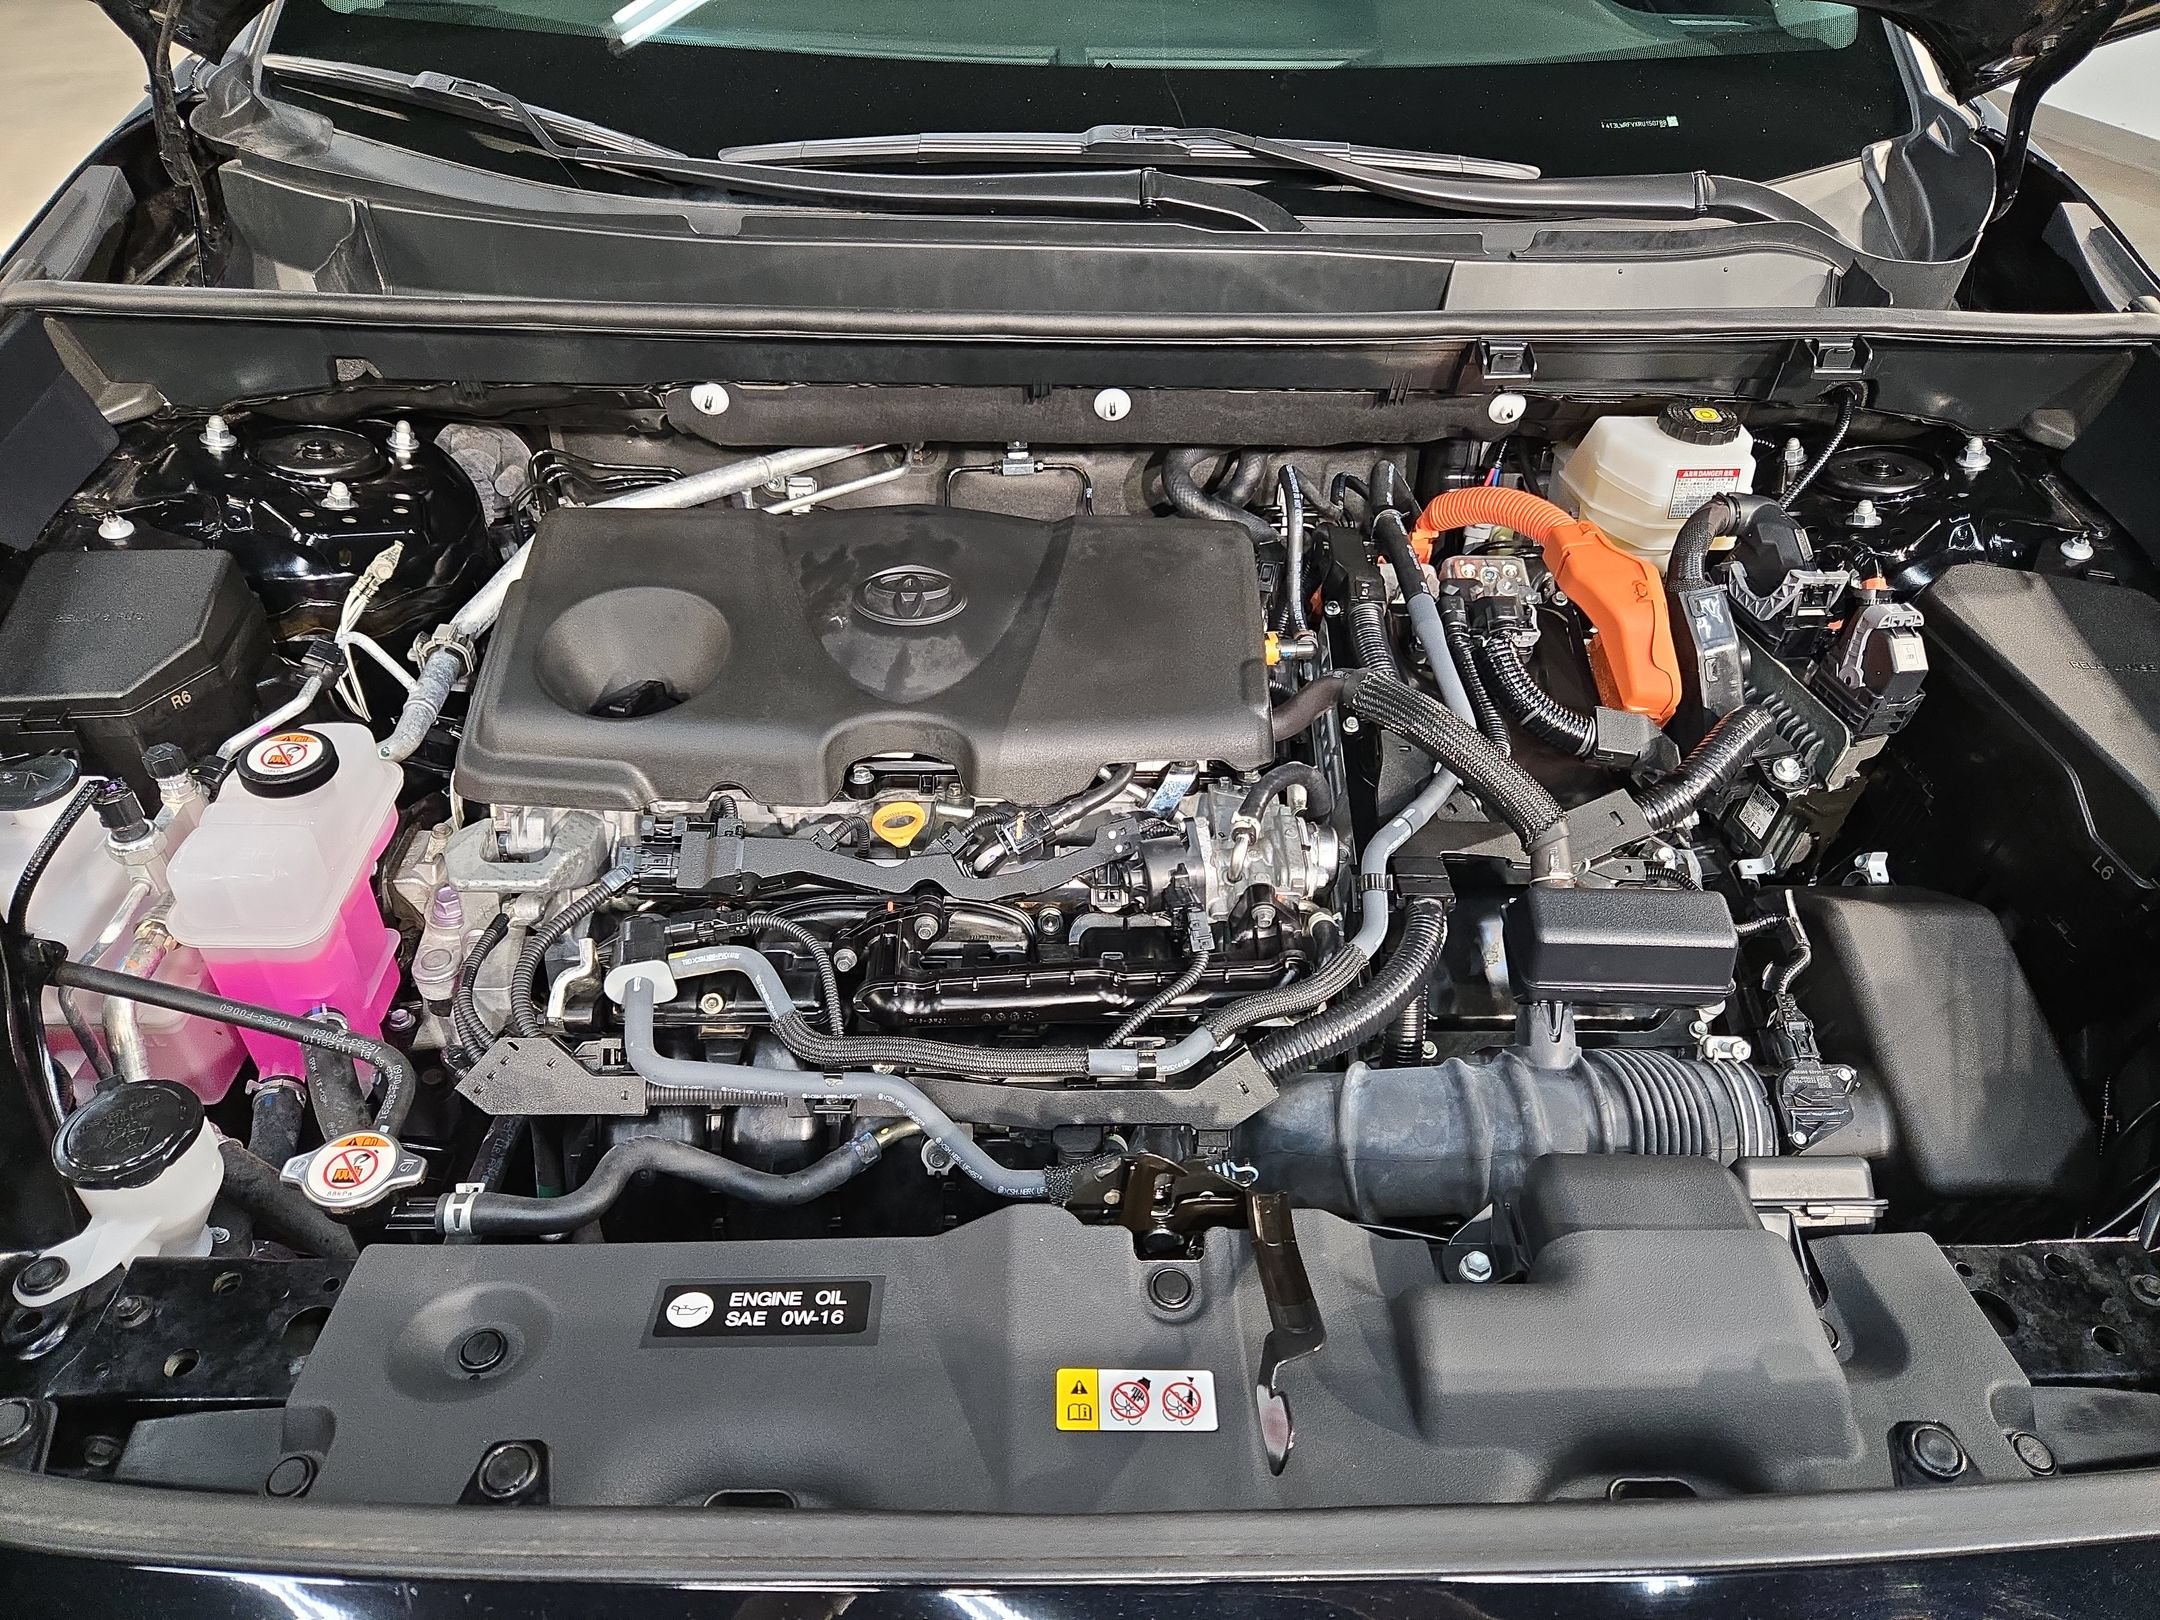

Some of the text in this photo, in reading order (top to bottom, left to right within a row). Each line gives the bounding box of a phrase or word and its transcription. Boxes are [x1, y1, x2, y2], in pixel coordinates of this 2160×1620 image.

[170, 690, 192, 710] R6
[2091, 855, 2115, 880] L6
[729, 1290, 848, 1307] ENGINE OIL
[724, 1309, 844, 1327] SAE 0W-16
